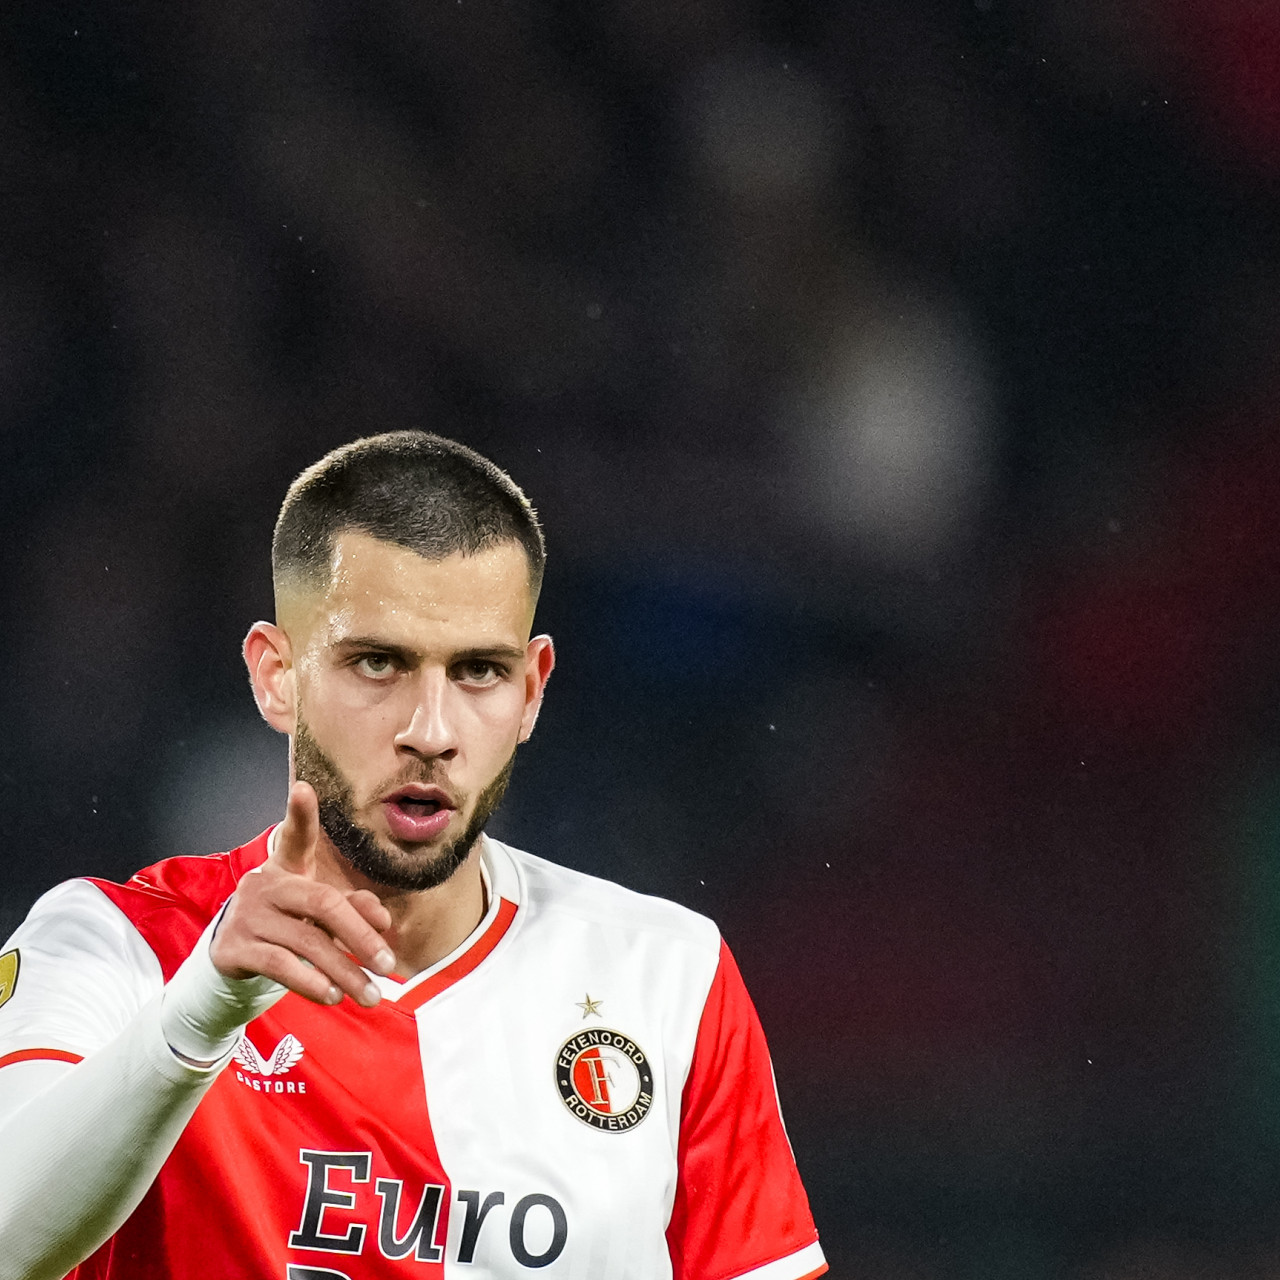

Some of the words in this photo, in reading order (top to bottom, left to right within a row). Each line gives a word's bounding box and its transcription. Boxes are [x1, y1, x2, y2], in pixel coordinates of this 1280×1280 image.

[558, 1031, 645, 1069] FEYENOORD
[236, 1070, 307, 1094] CASTORE
[565, 1091, 652, 1130] ROTTERDAM
[288, 1148, 568, 1269] Euro
